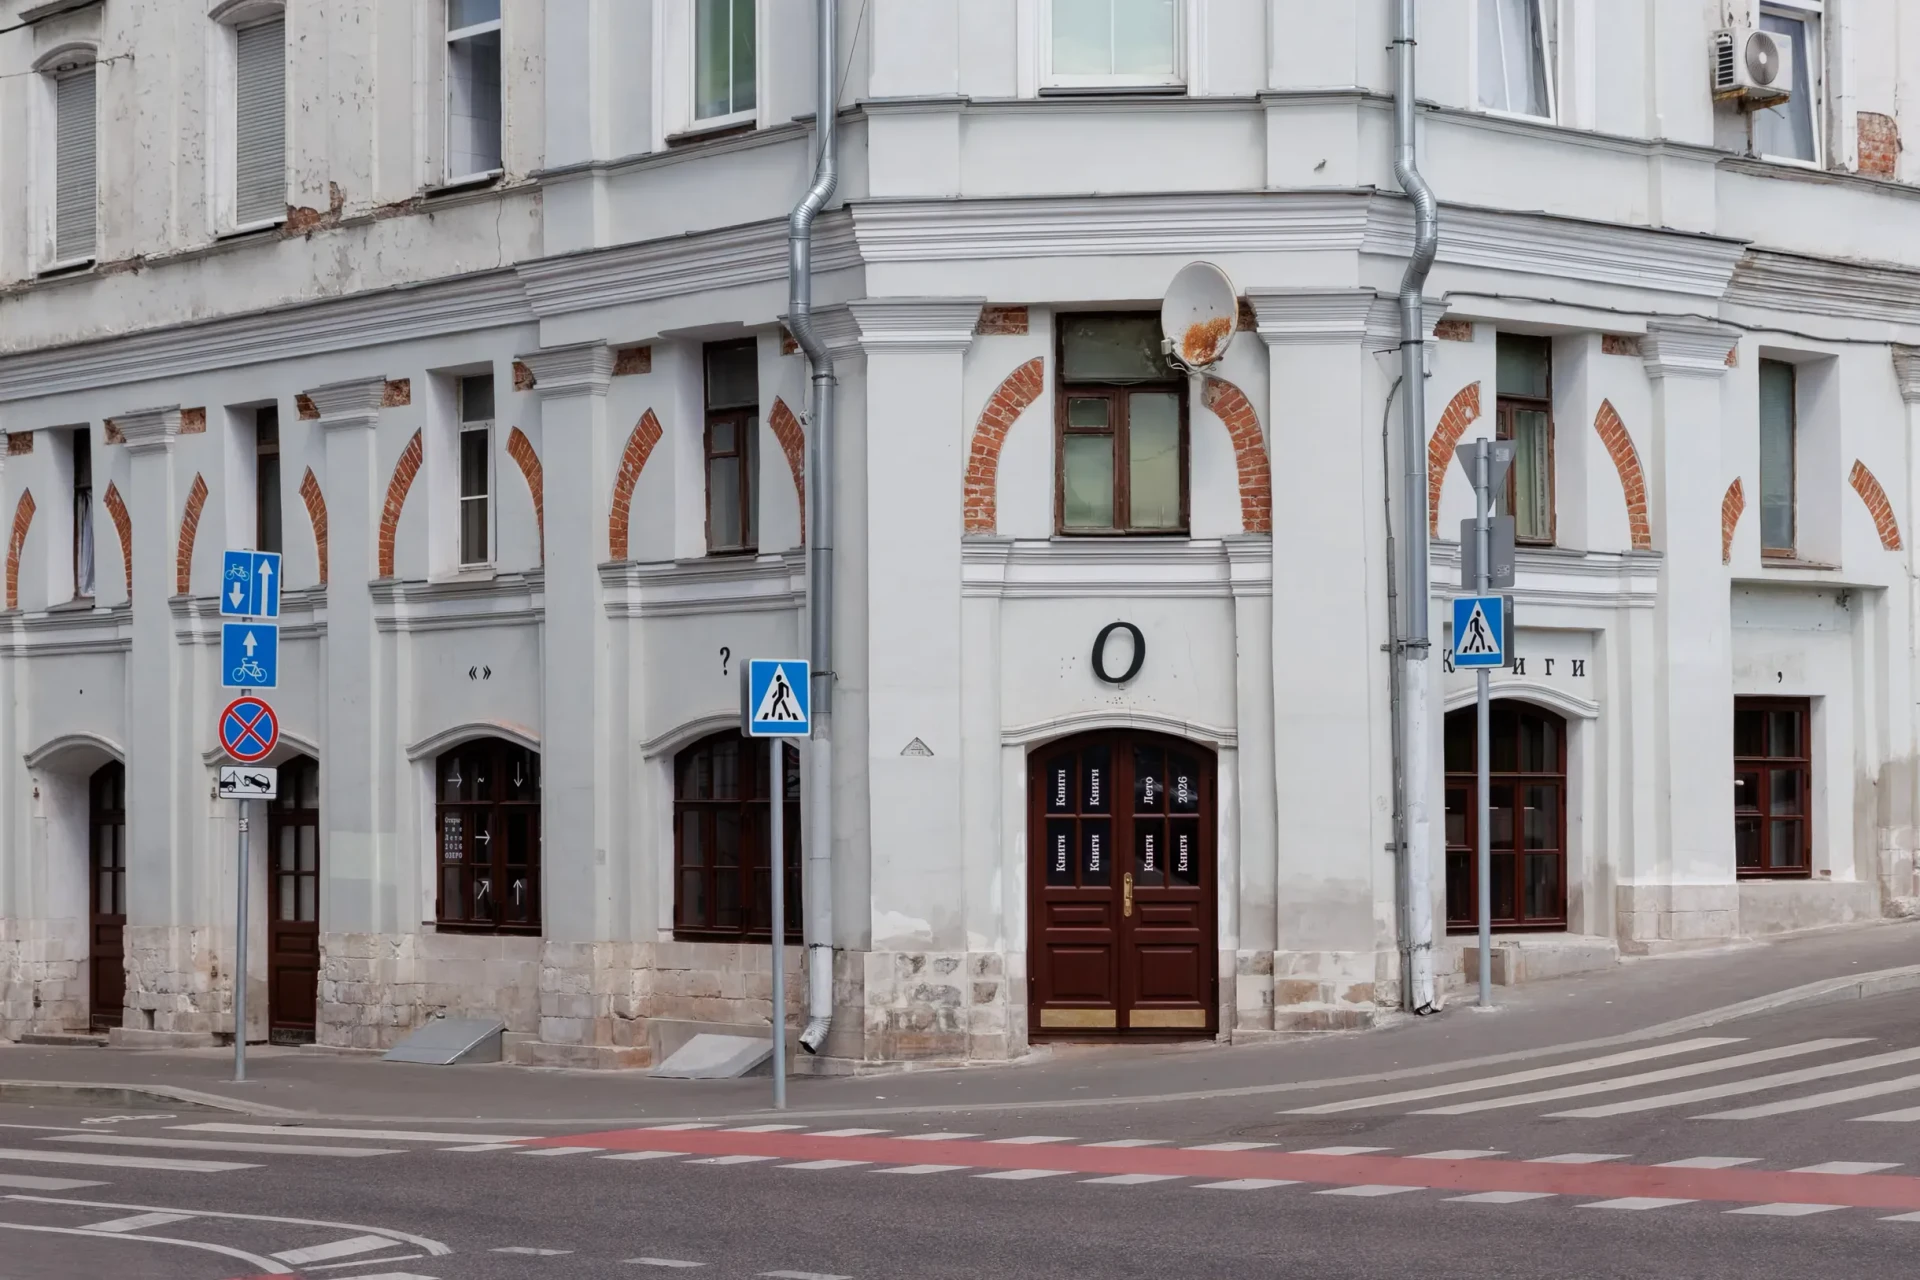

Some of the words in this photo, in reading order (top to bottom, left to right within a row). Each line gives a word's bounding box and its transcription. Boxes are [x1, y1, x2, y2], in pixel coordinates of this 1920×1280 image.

[720, 646, 730, 676] ?
[1443, 648, 1585, 677] Киги
[1056, 769, 1066, 806] Книги
[1089, 768, 1099, 806] Книги
[1143, 776, 1154, 805] Лето
[1178, 776, 1188, 804] 2026
[1056, 834, 1066, 872] Книги
[1089, 834, 1099, 872] Книги
[1143, 834, 1154, 872] Книги
[1178, 834, 1188, 872] Книги
